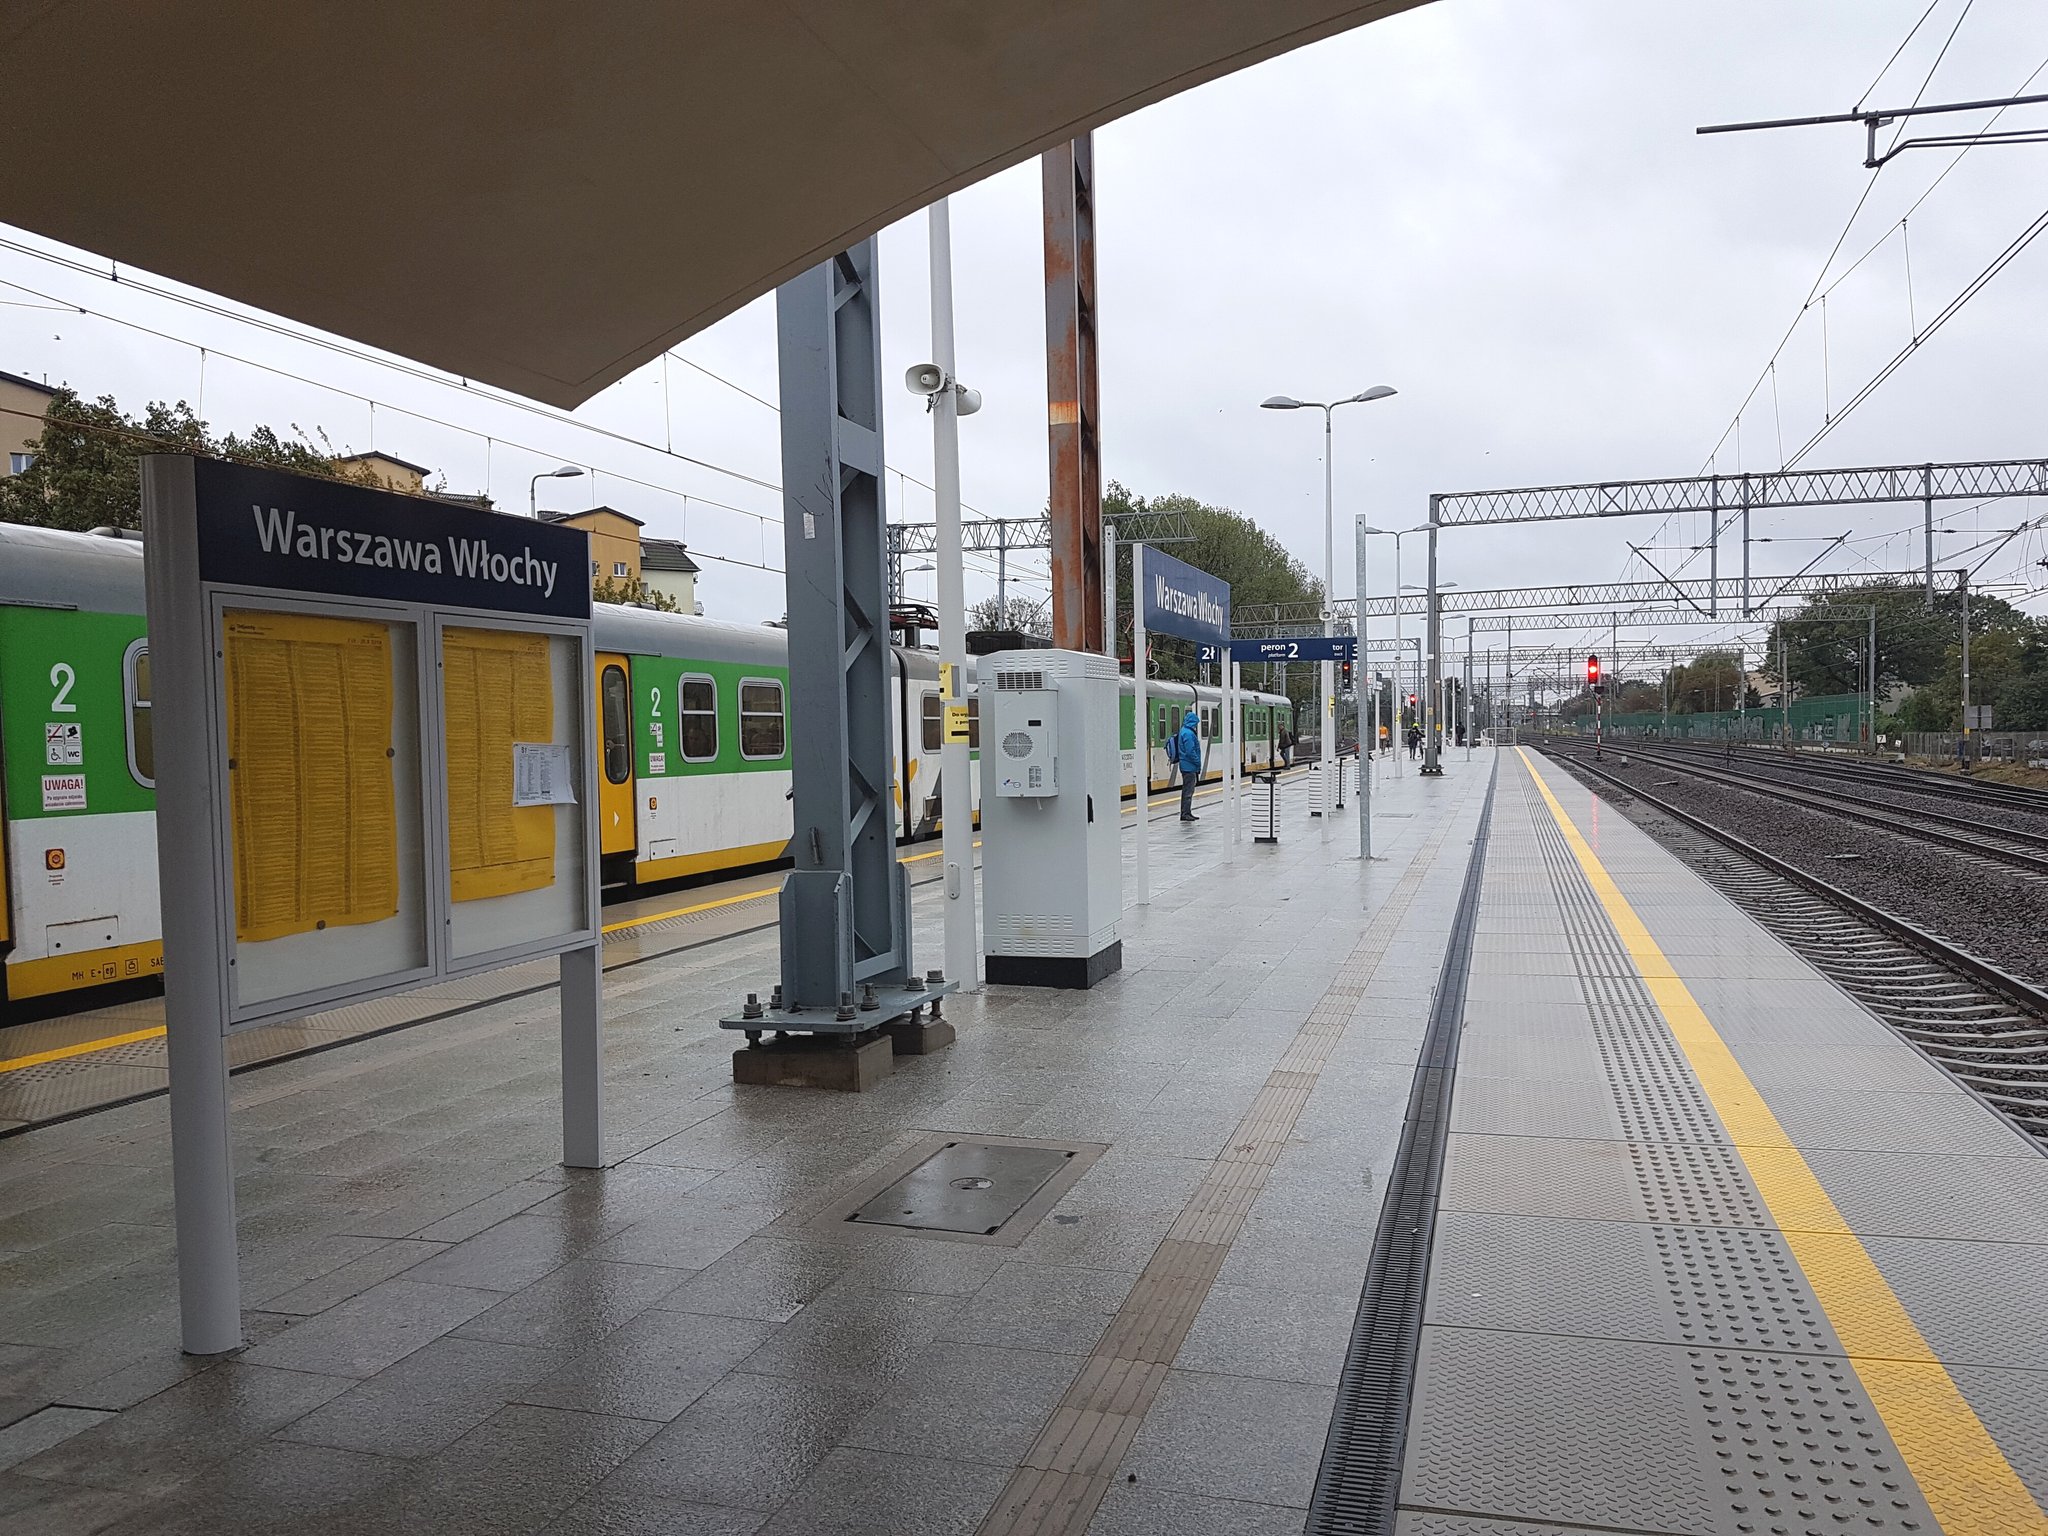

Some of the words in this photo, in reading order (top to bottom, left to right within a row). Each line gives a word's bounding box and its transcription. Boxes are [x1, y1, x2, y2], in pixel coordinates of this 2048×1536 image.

[252, 504, 442, 574] Warszawa
[447, 536, 558, 598] Włochy
[1155, 574, 1198, 619] Warszawa
[1198, 590, 1224, 634] Włochy
[1260, 644, 1286, 653] peron
[1287, 642, 1299, 658] 2
[50, 662, 77, 713] 2
[651, 687, 661, 716] 2
[67, 750, 80, 758] WC
[44, 779, 84, 790] UWAGA!
[72, 972, 84, 980] MH
